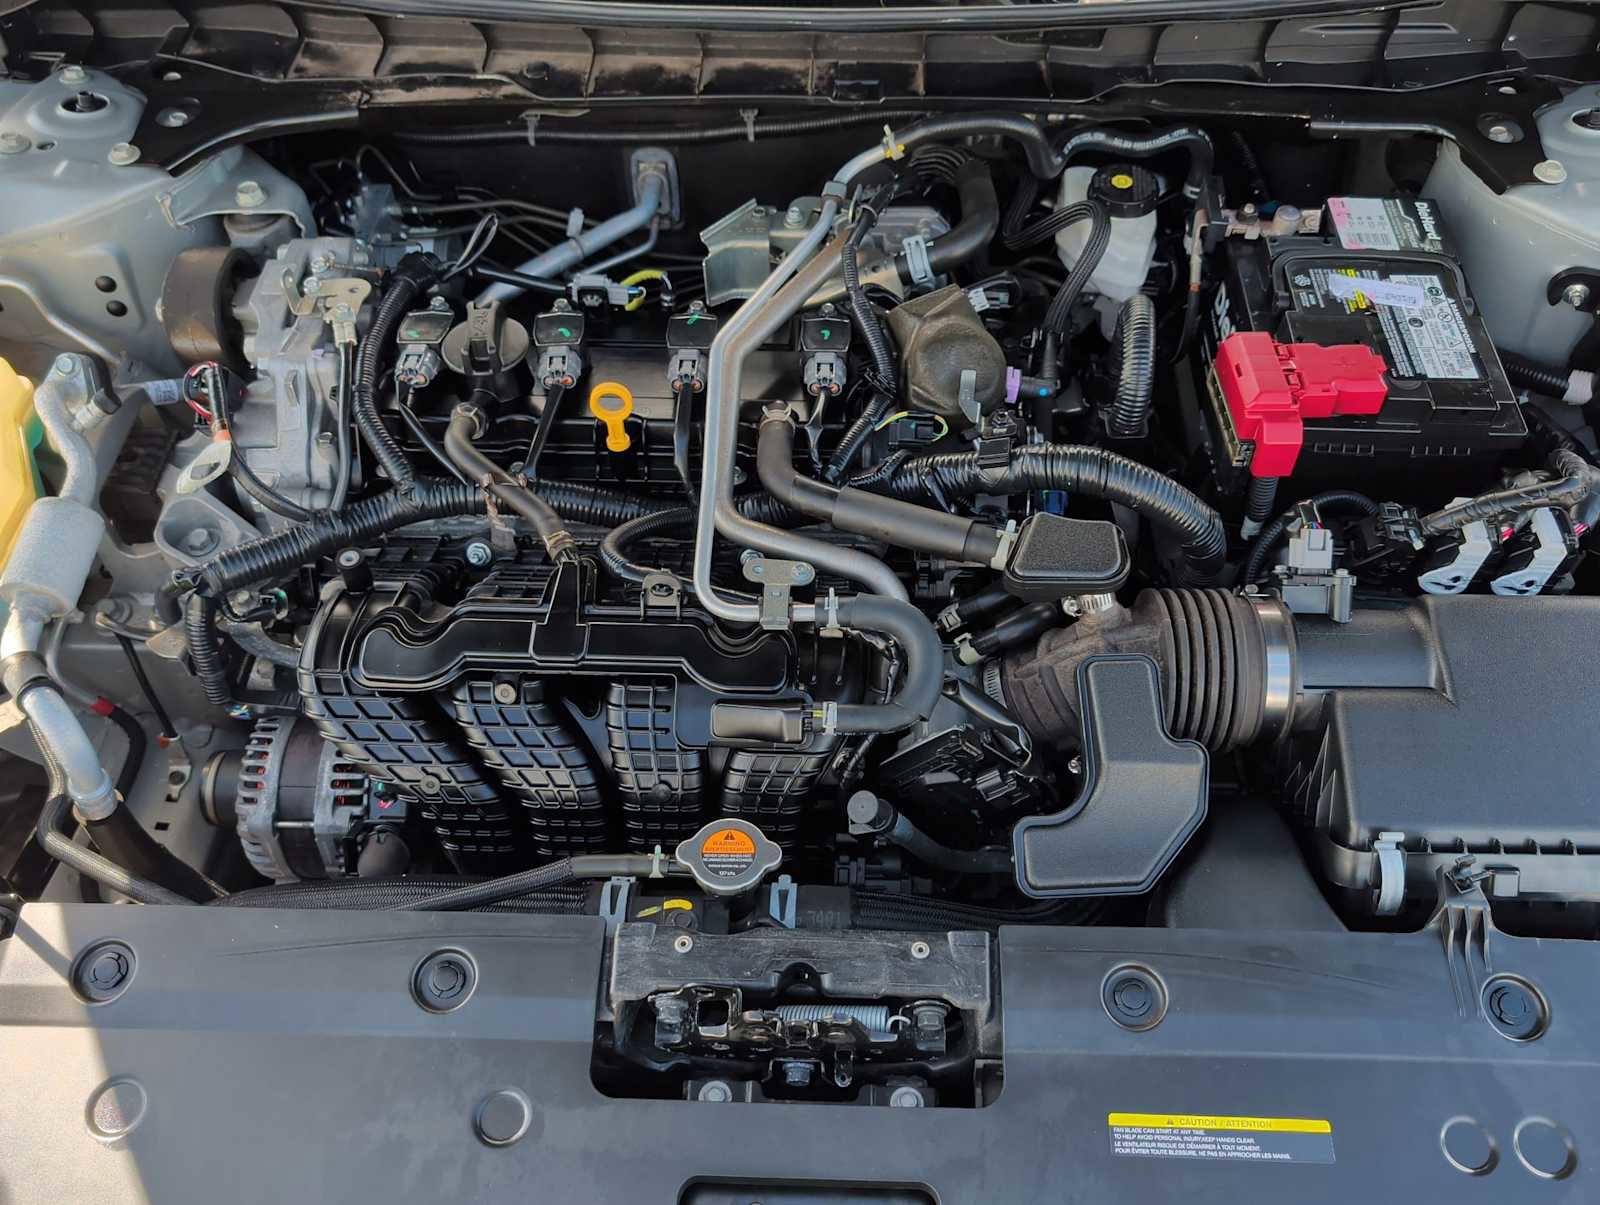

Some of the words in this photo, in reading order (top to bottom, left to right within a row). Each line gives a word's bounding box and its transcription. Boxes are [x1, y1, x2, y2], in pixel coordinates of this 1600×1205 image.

[1414, 202, 1441, 240] DieHard
[1214, 281, 1236, 341] Die
[1179, 1118, 1217, 1126] CAUTION
[1225, 1120, 1272, 1129] ATTENTION
[1186, 1142, 1216, 1150] DÉMARRER
[1132, 1147, 1150, 1155] ÉVITER
[1227, 1151, 1261, 1159] APPROCHER
